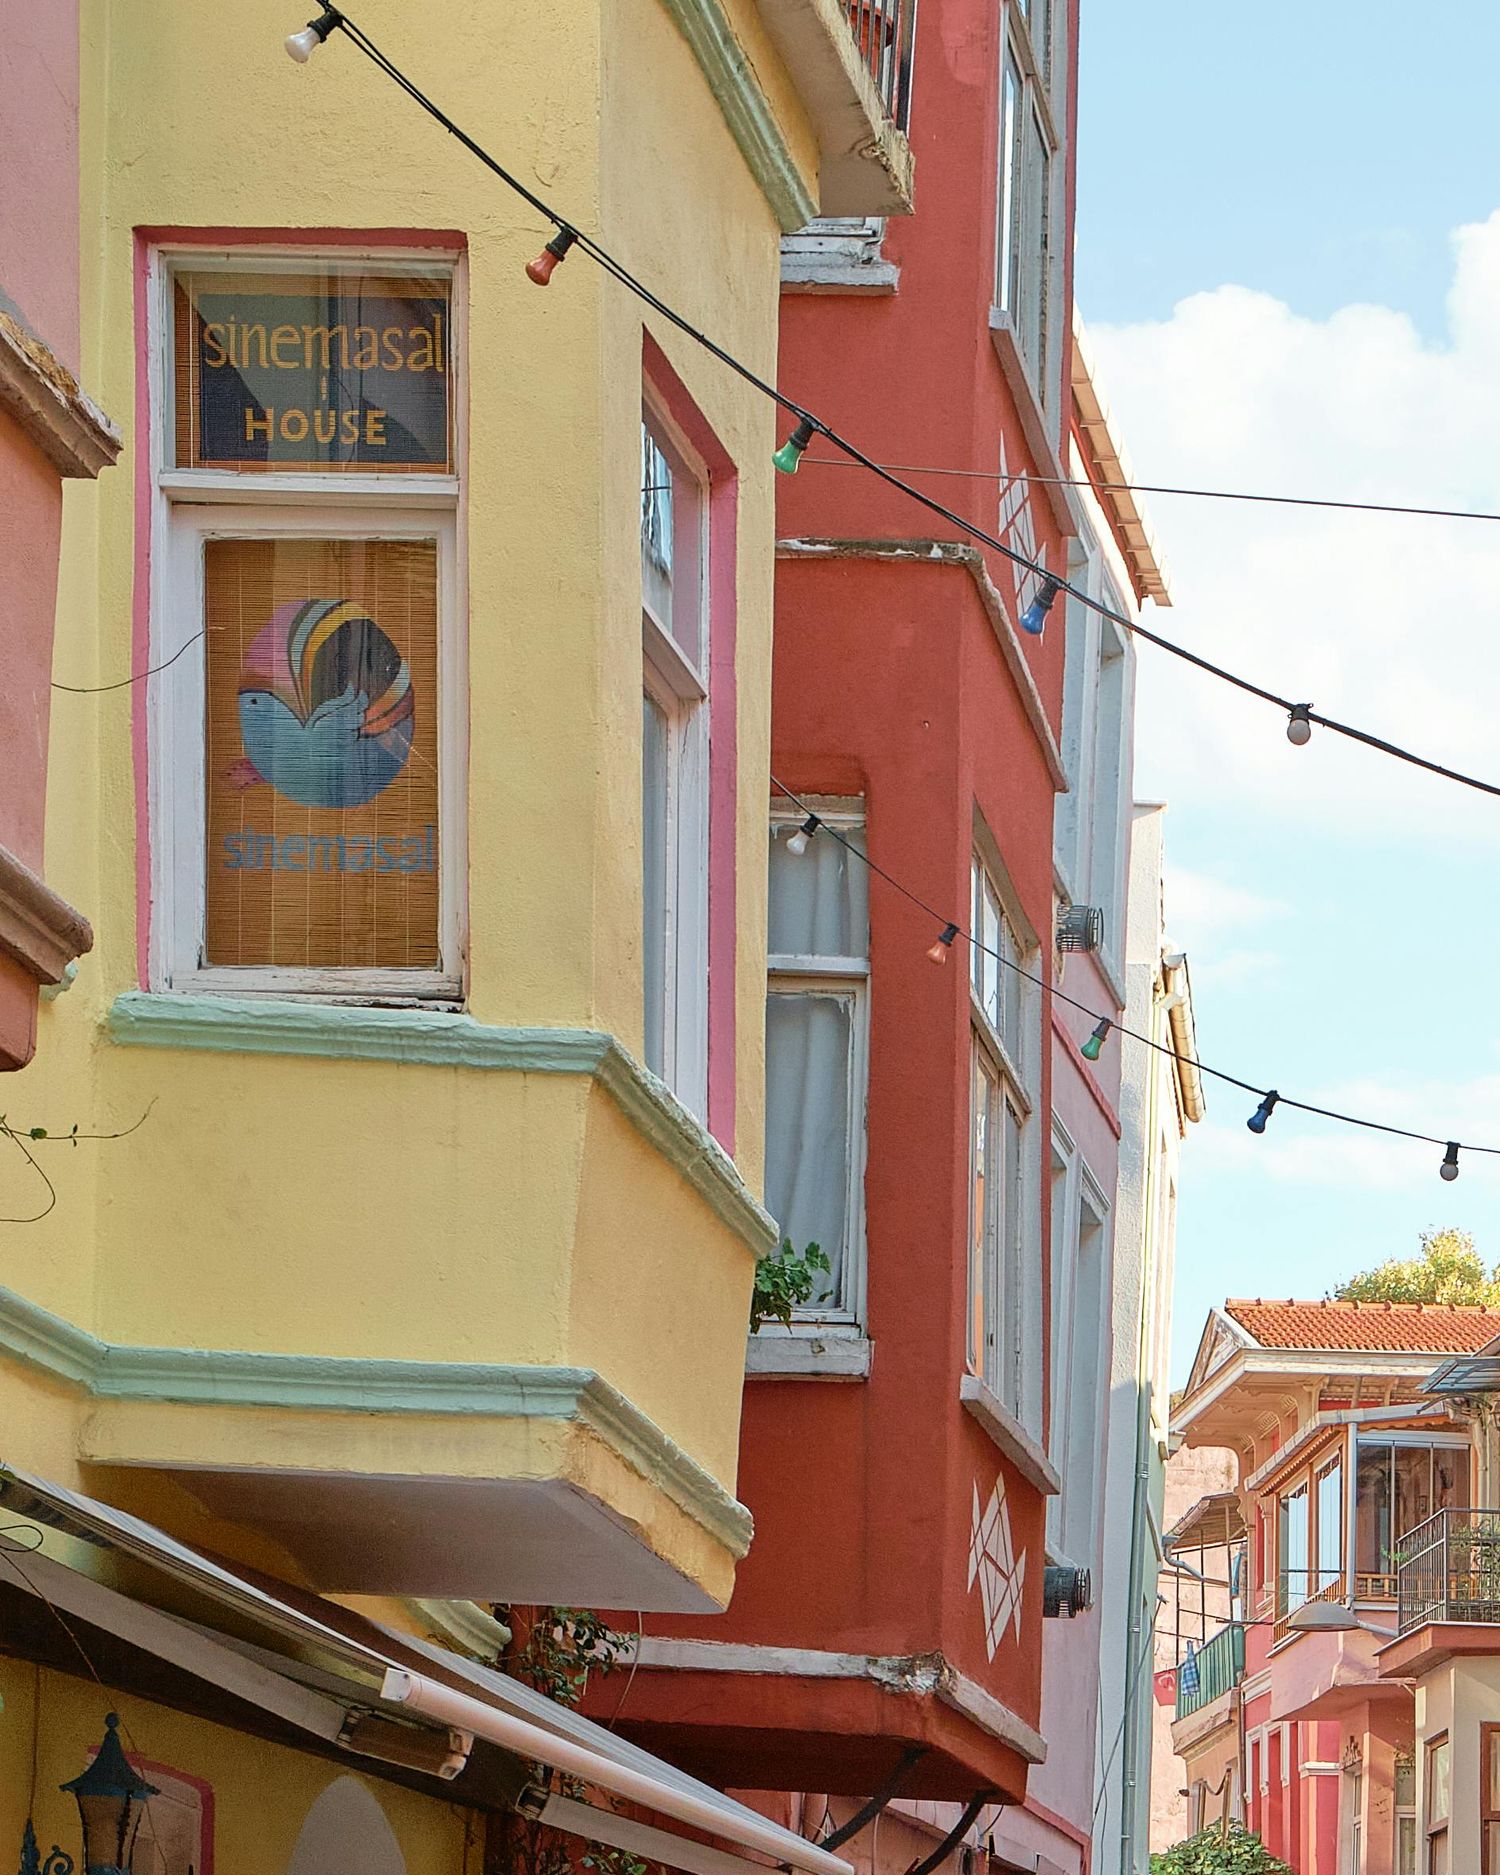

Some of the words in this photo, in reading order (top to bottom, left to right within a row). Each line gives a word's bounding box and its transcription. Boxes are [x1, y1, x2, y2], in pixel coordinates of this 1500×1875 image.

[203, 311, 445, 372] sinemasal
[244, 407, 387, 446] HOUSE
[223, 823, 434, 873] sinemasal
